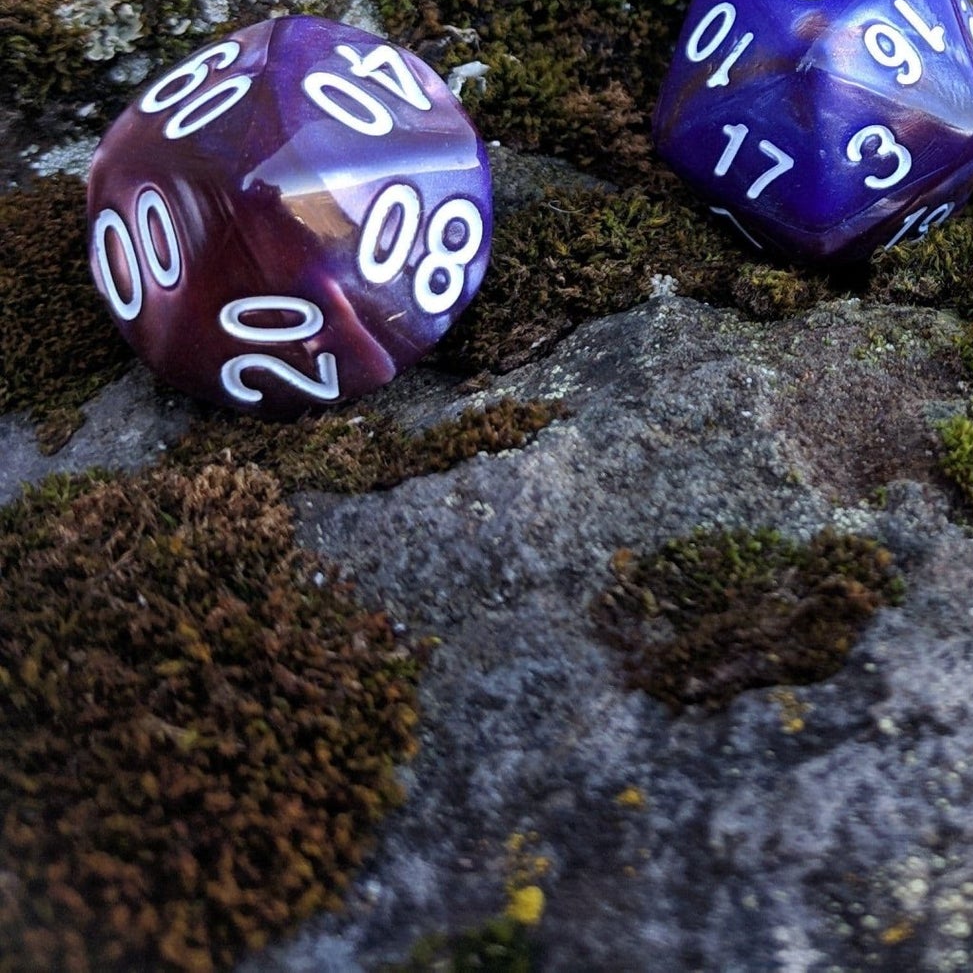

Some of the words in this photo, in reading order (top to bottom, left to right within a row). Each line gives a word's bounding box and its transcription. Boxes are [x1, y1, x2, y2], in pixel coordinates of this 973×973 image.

[303, 44, 432, 137] 40
[714, 123, 795, 199] 17
[846, 124, 912, 190] 3
[96, 189, 181, 320] 00
[358, 183, 483, 314] 80
[219, 295, 340, 403] 20
